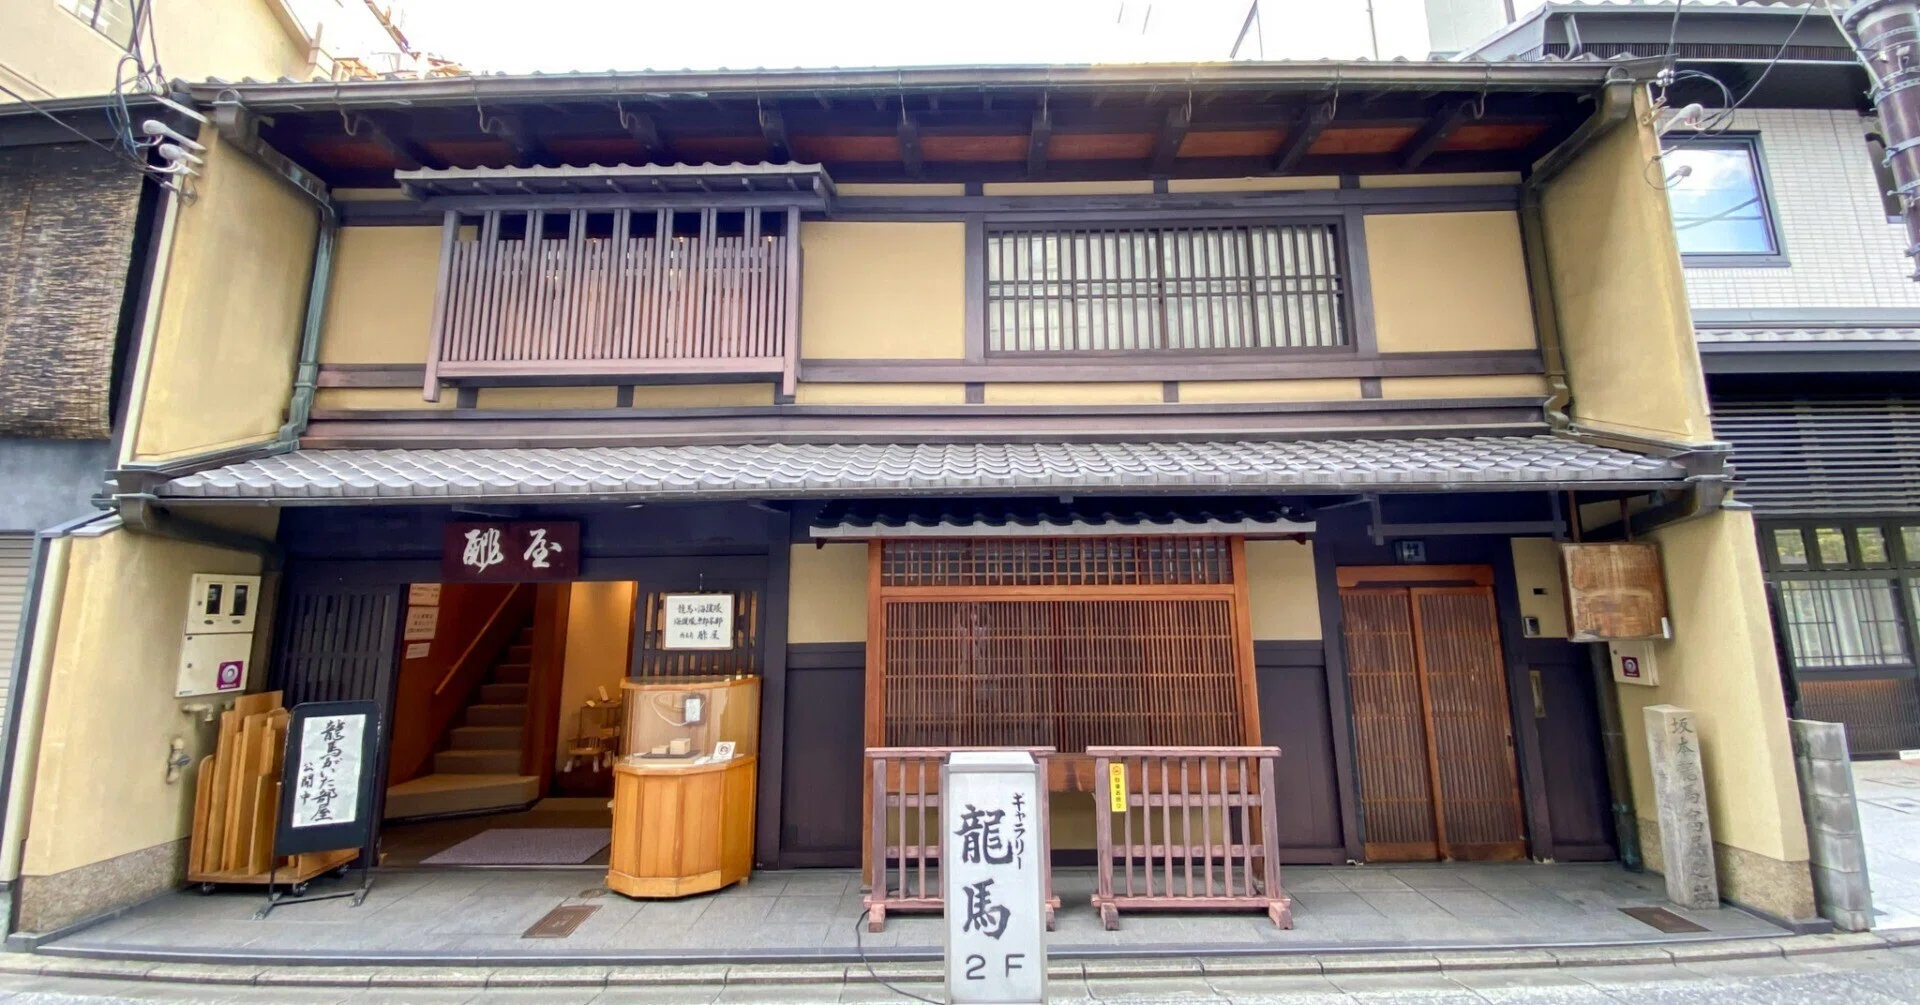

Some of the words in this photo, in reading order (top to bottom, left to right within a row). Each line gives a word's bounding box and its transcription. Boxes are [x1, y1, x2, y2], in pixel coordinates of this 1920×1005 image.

[300, 762, 314, 806] 公開中
[311, 720, 346, 822] 龍馬がいた部屋
[953, 804, 1014, 941] 龍馬
[1011, 792, 1026, 870] ギャラリー
